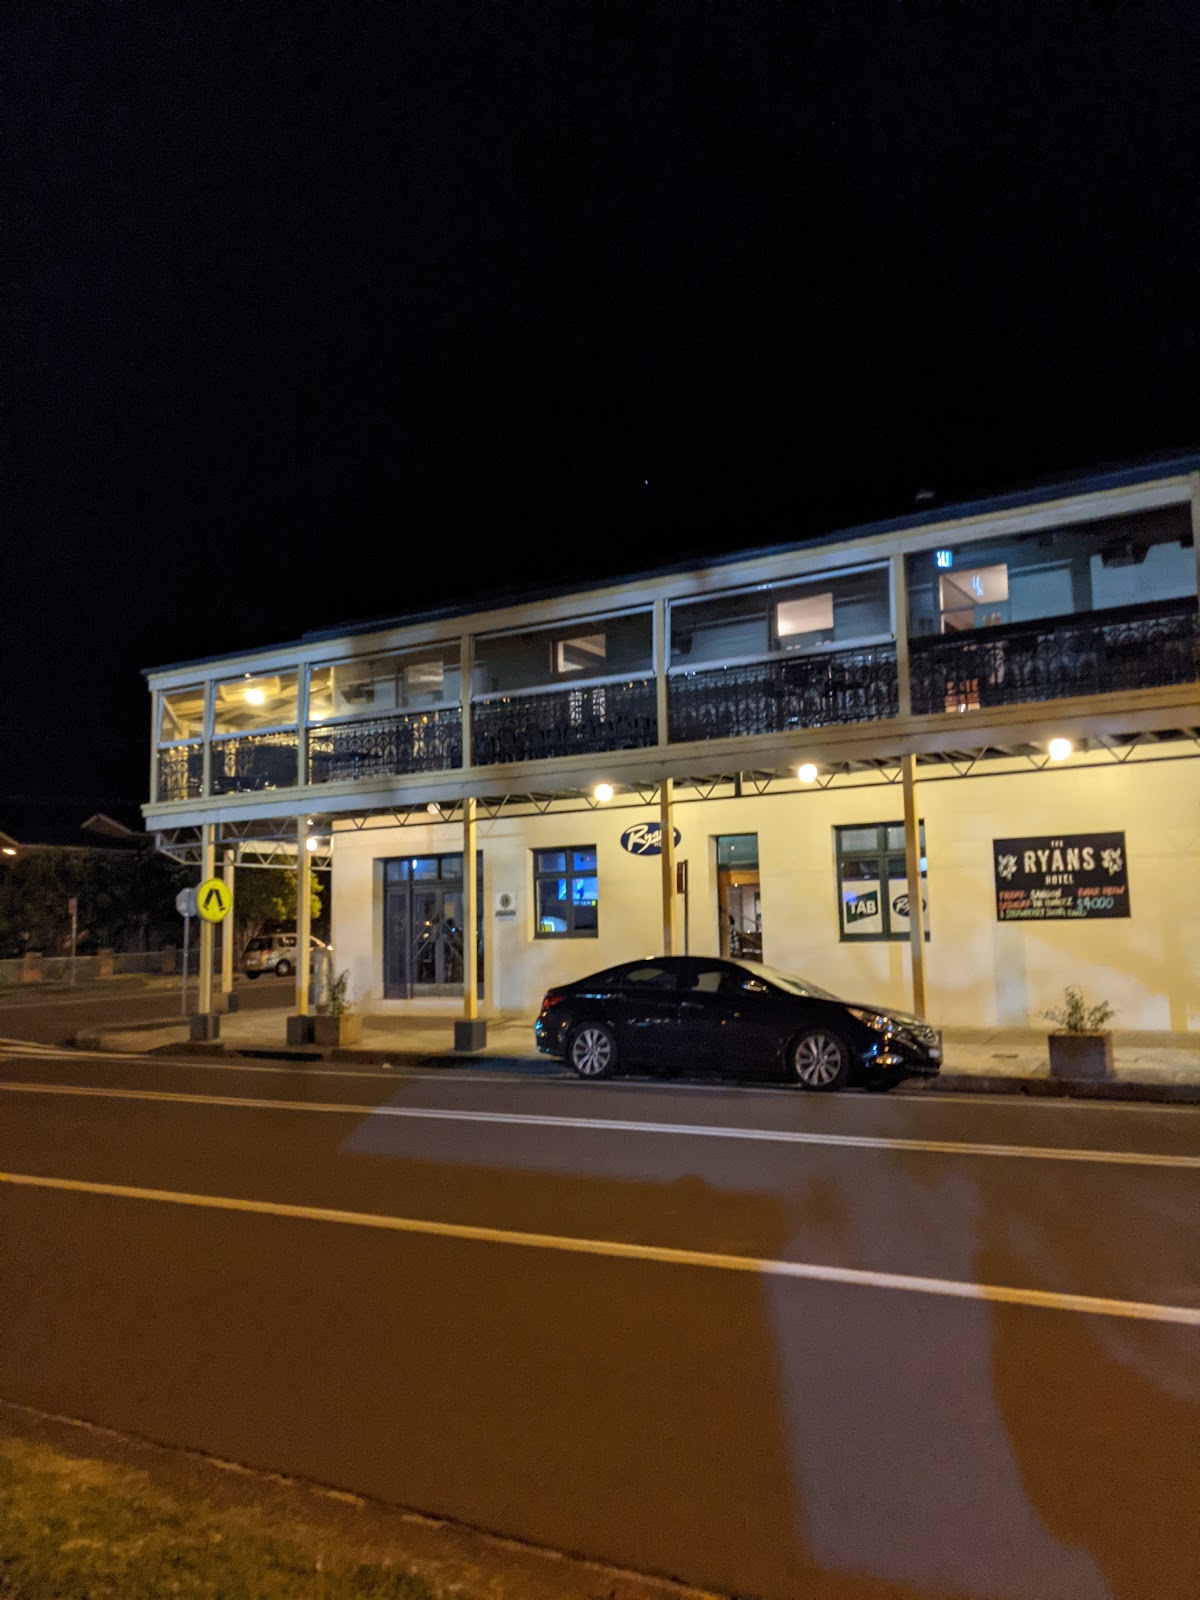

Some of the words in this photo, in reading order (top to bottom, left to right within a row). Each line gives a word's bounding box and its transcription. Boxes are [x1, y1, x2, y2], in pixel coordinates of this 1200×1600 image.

[1024, 847, 1095, 873] RYANS
[1045, 873, 1074, 886] HOTEL
[848, 900, 877, 915] TAB
